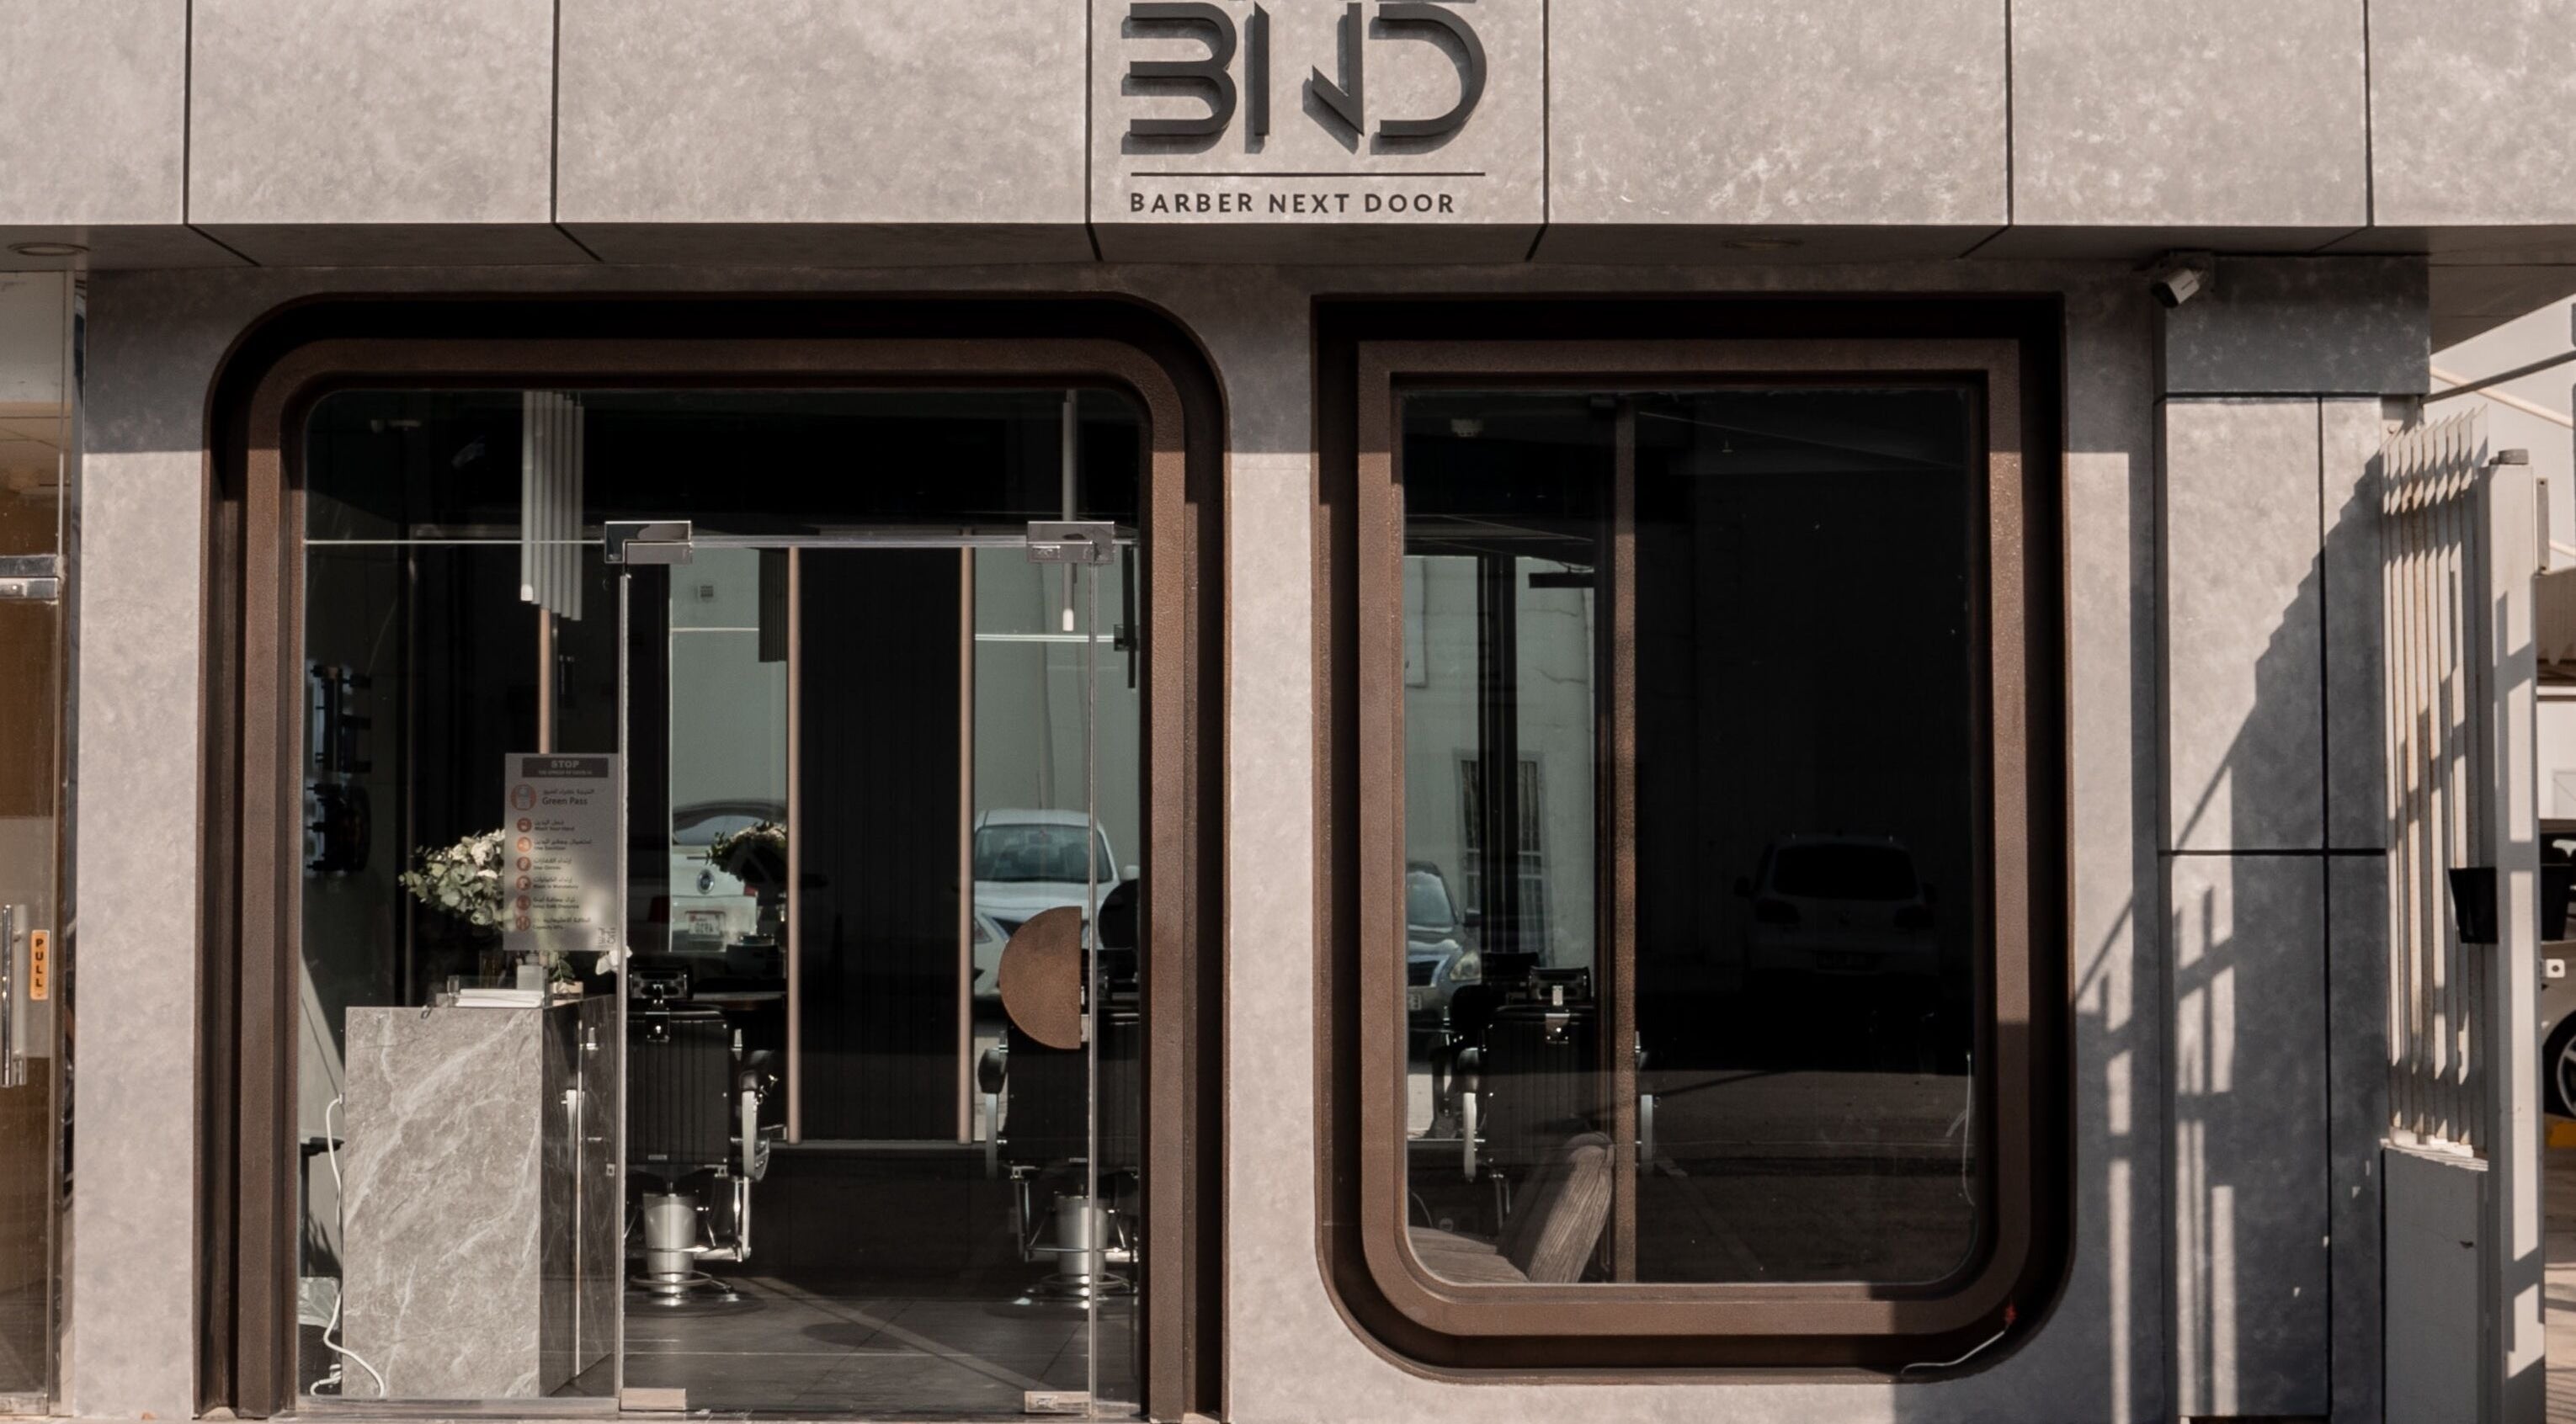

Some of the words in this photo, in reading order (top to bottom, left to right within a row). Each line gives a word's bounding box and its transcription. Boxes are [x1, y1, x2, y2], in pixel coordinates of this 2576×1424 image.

[1130, 192, 1253, 213] BARBER
[1269, 193, 1349, 213] NEXT
[1365, 194, 1454, 213] DOOR
[551, 760, 580, 768] STOP
[541, 796, 567, 805] Green
[569, 796, 588, 805] Pass
[35, 938, 44, 987] PULL
